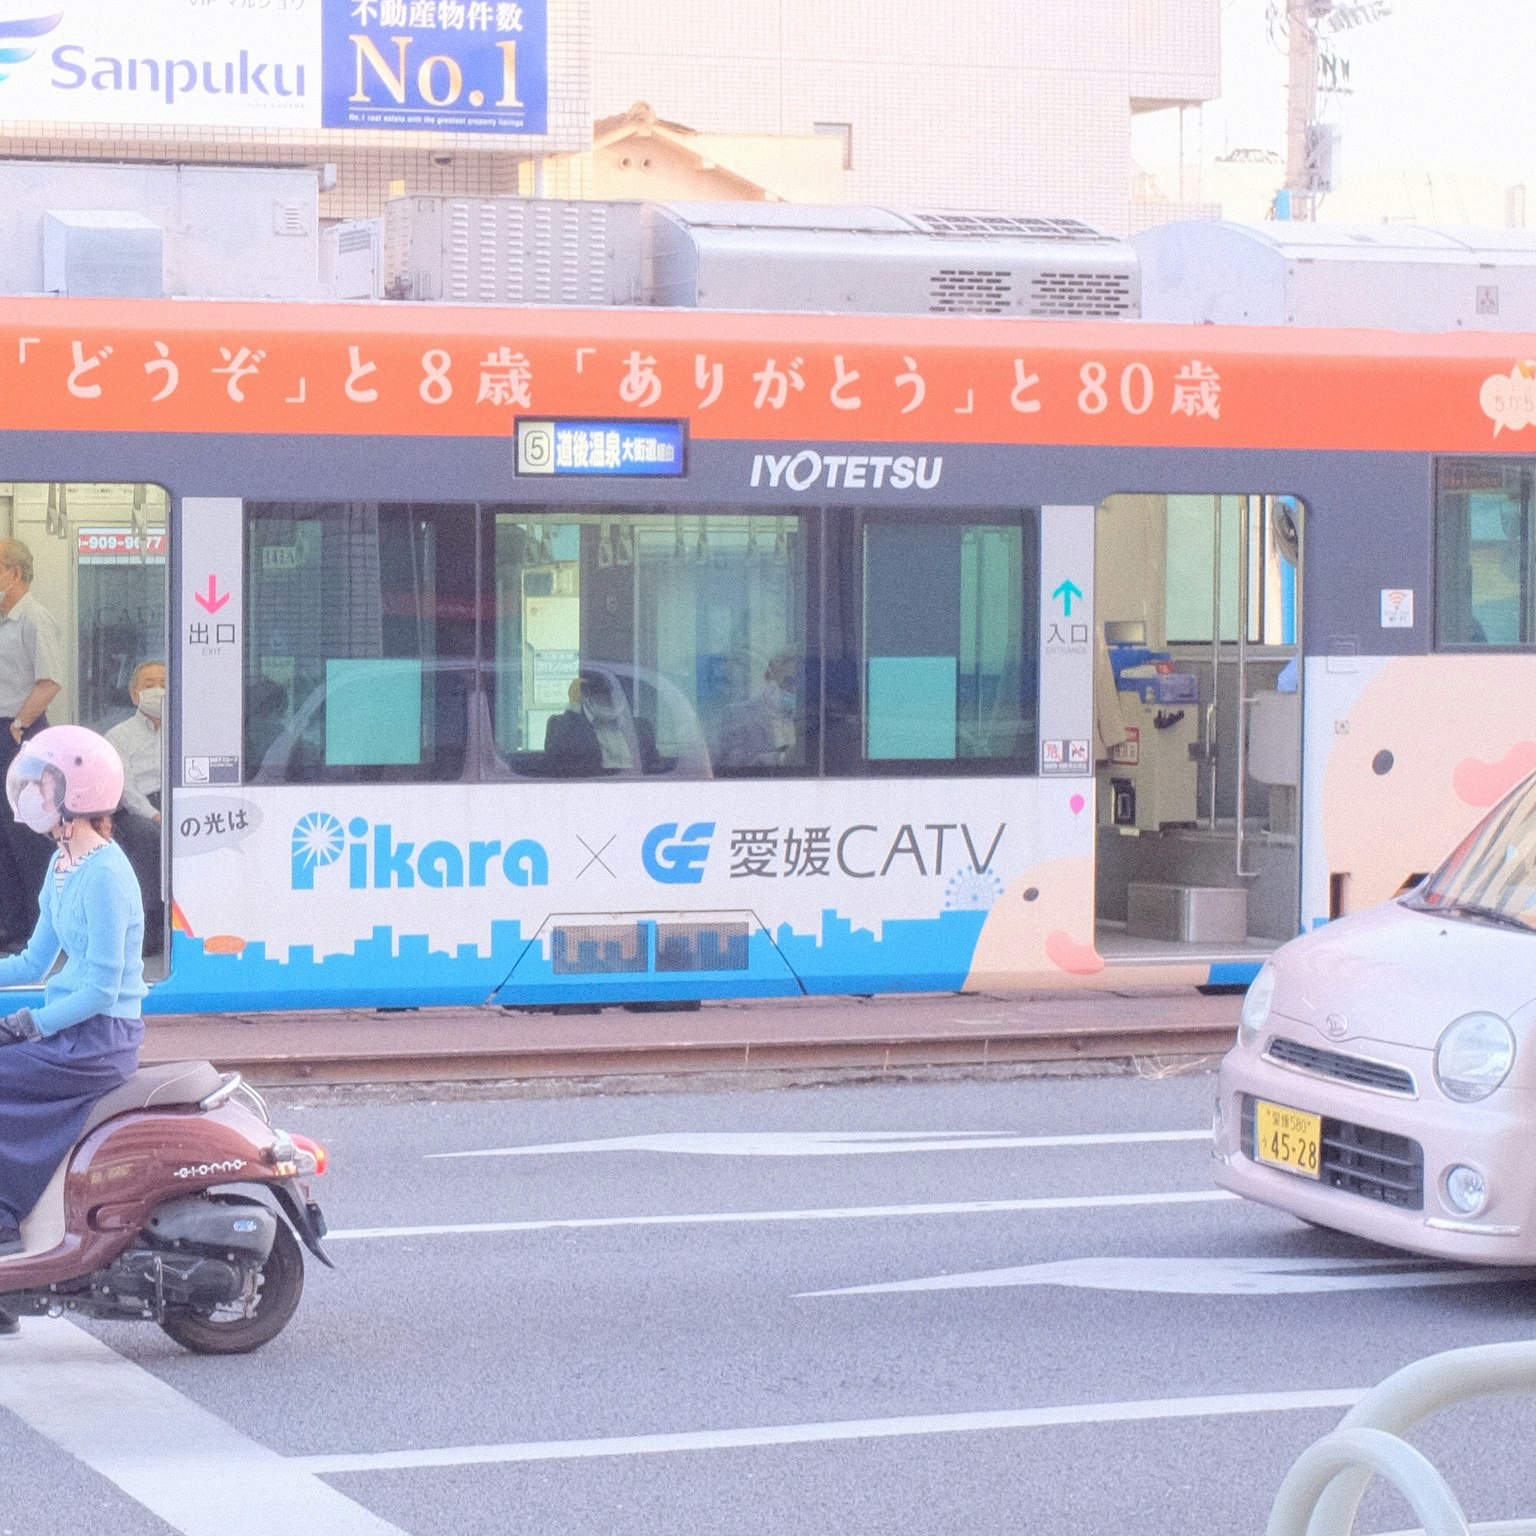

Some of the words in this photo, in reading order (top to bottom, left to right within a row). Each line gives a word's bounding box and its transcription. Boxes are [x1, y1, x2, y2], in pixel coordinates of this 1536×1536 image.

[50, 44, 306, 105] Sanpuku
[348, 34, 525, 108] No.1
[750, 449, 943, 490] IYOTETSU
[189, 622, 235, 645] 出口
[1046, 623, 1088, 644] 入口
[180, 808, 249, 838] の光は
[291, 811, 549, 890] Pikara
